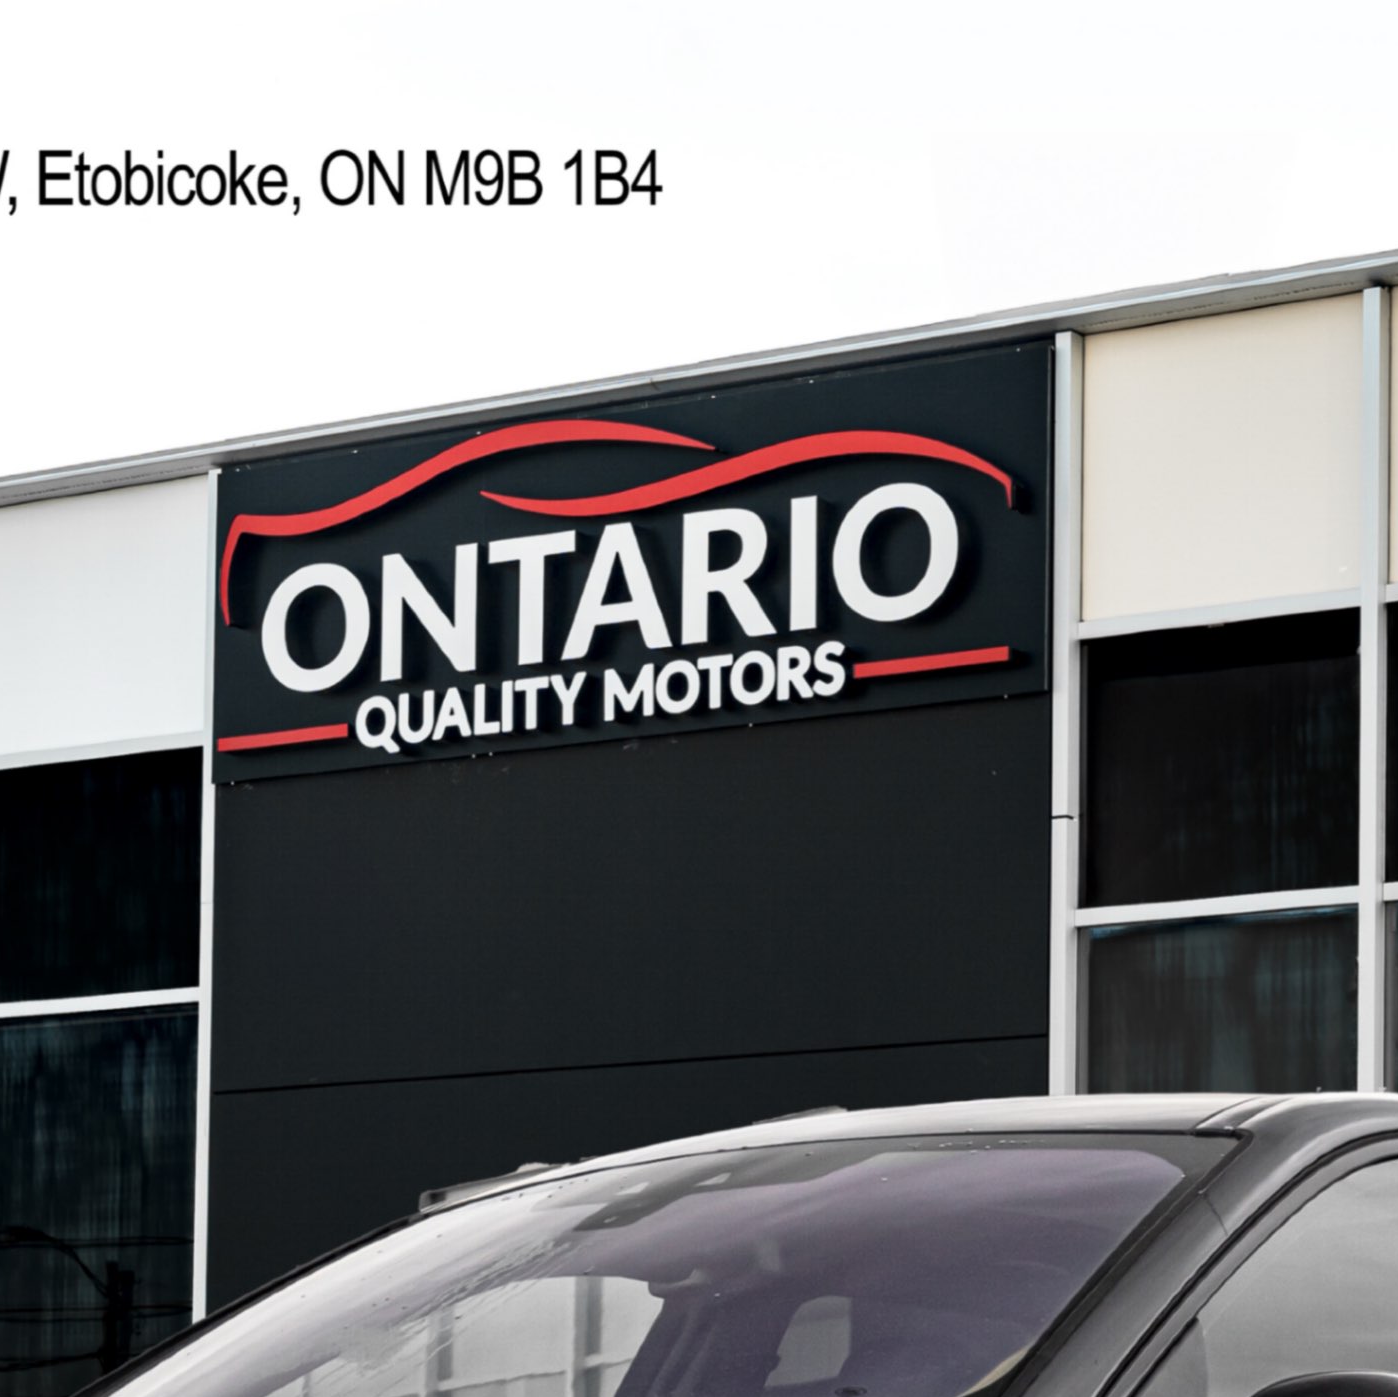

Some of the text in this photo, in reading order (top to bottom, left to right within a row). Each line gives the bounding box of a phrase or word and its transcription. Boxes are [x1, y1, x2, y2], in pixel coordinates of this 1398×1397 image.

[261, 482, 959, 692] ONTARIO
[355, 640, 846, 753] QUALITY MOTORS
